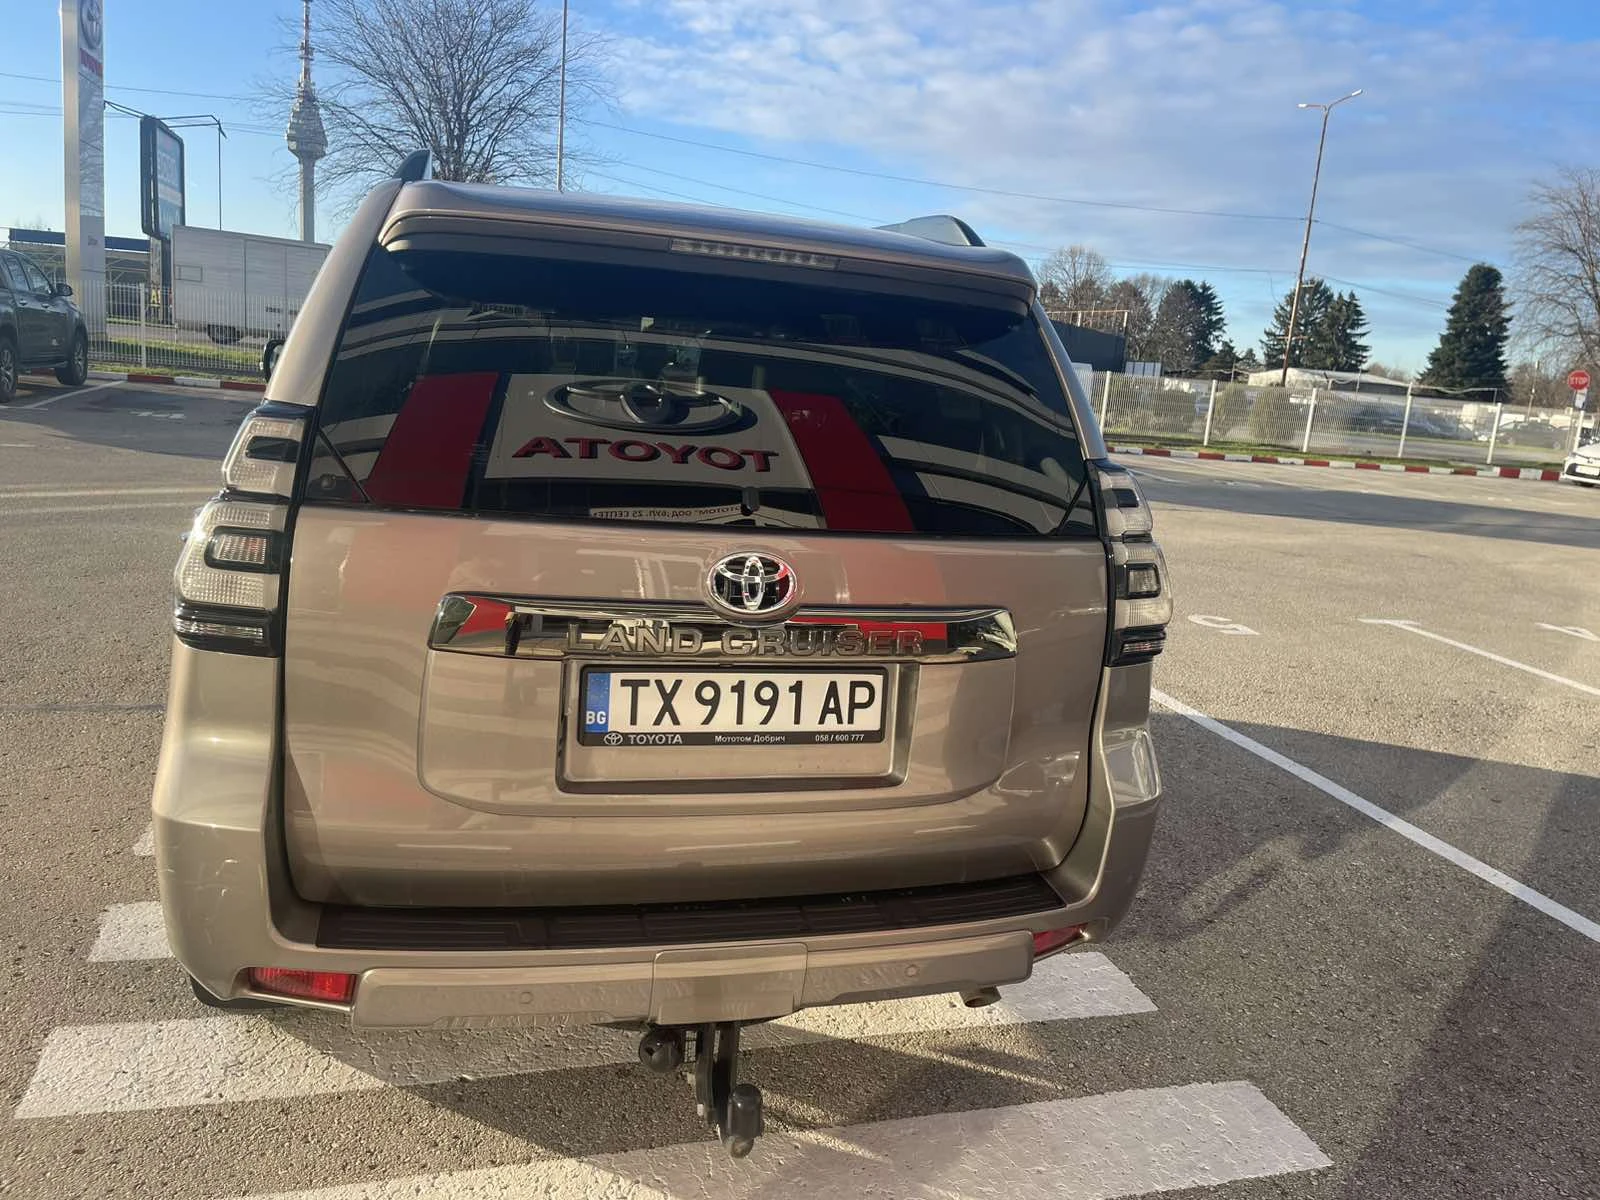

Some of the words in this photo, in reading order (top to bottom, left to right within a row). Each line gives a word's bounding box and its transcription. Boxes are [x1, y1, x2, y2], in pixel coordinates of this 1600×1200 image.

[1569, 375, 1588, 385] STOP
[566, 622, 703, 655] LAND
[720, 627, 925, 657] CRUISER
[620, 679, 683, 726] TX
[695, 680, 803, 726] 9191
[817, 680, 876, 725] AP
[585, 711, 607, 725] BG
[628, 734, 683, 745] TOYOTA
[714, 735, 752, 743] Мототом
[753, 734, 786, 744] Добрич
[851, 734, 865, 742] 777
